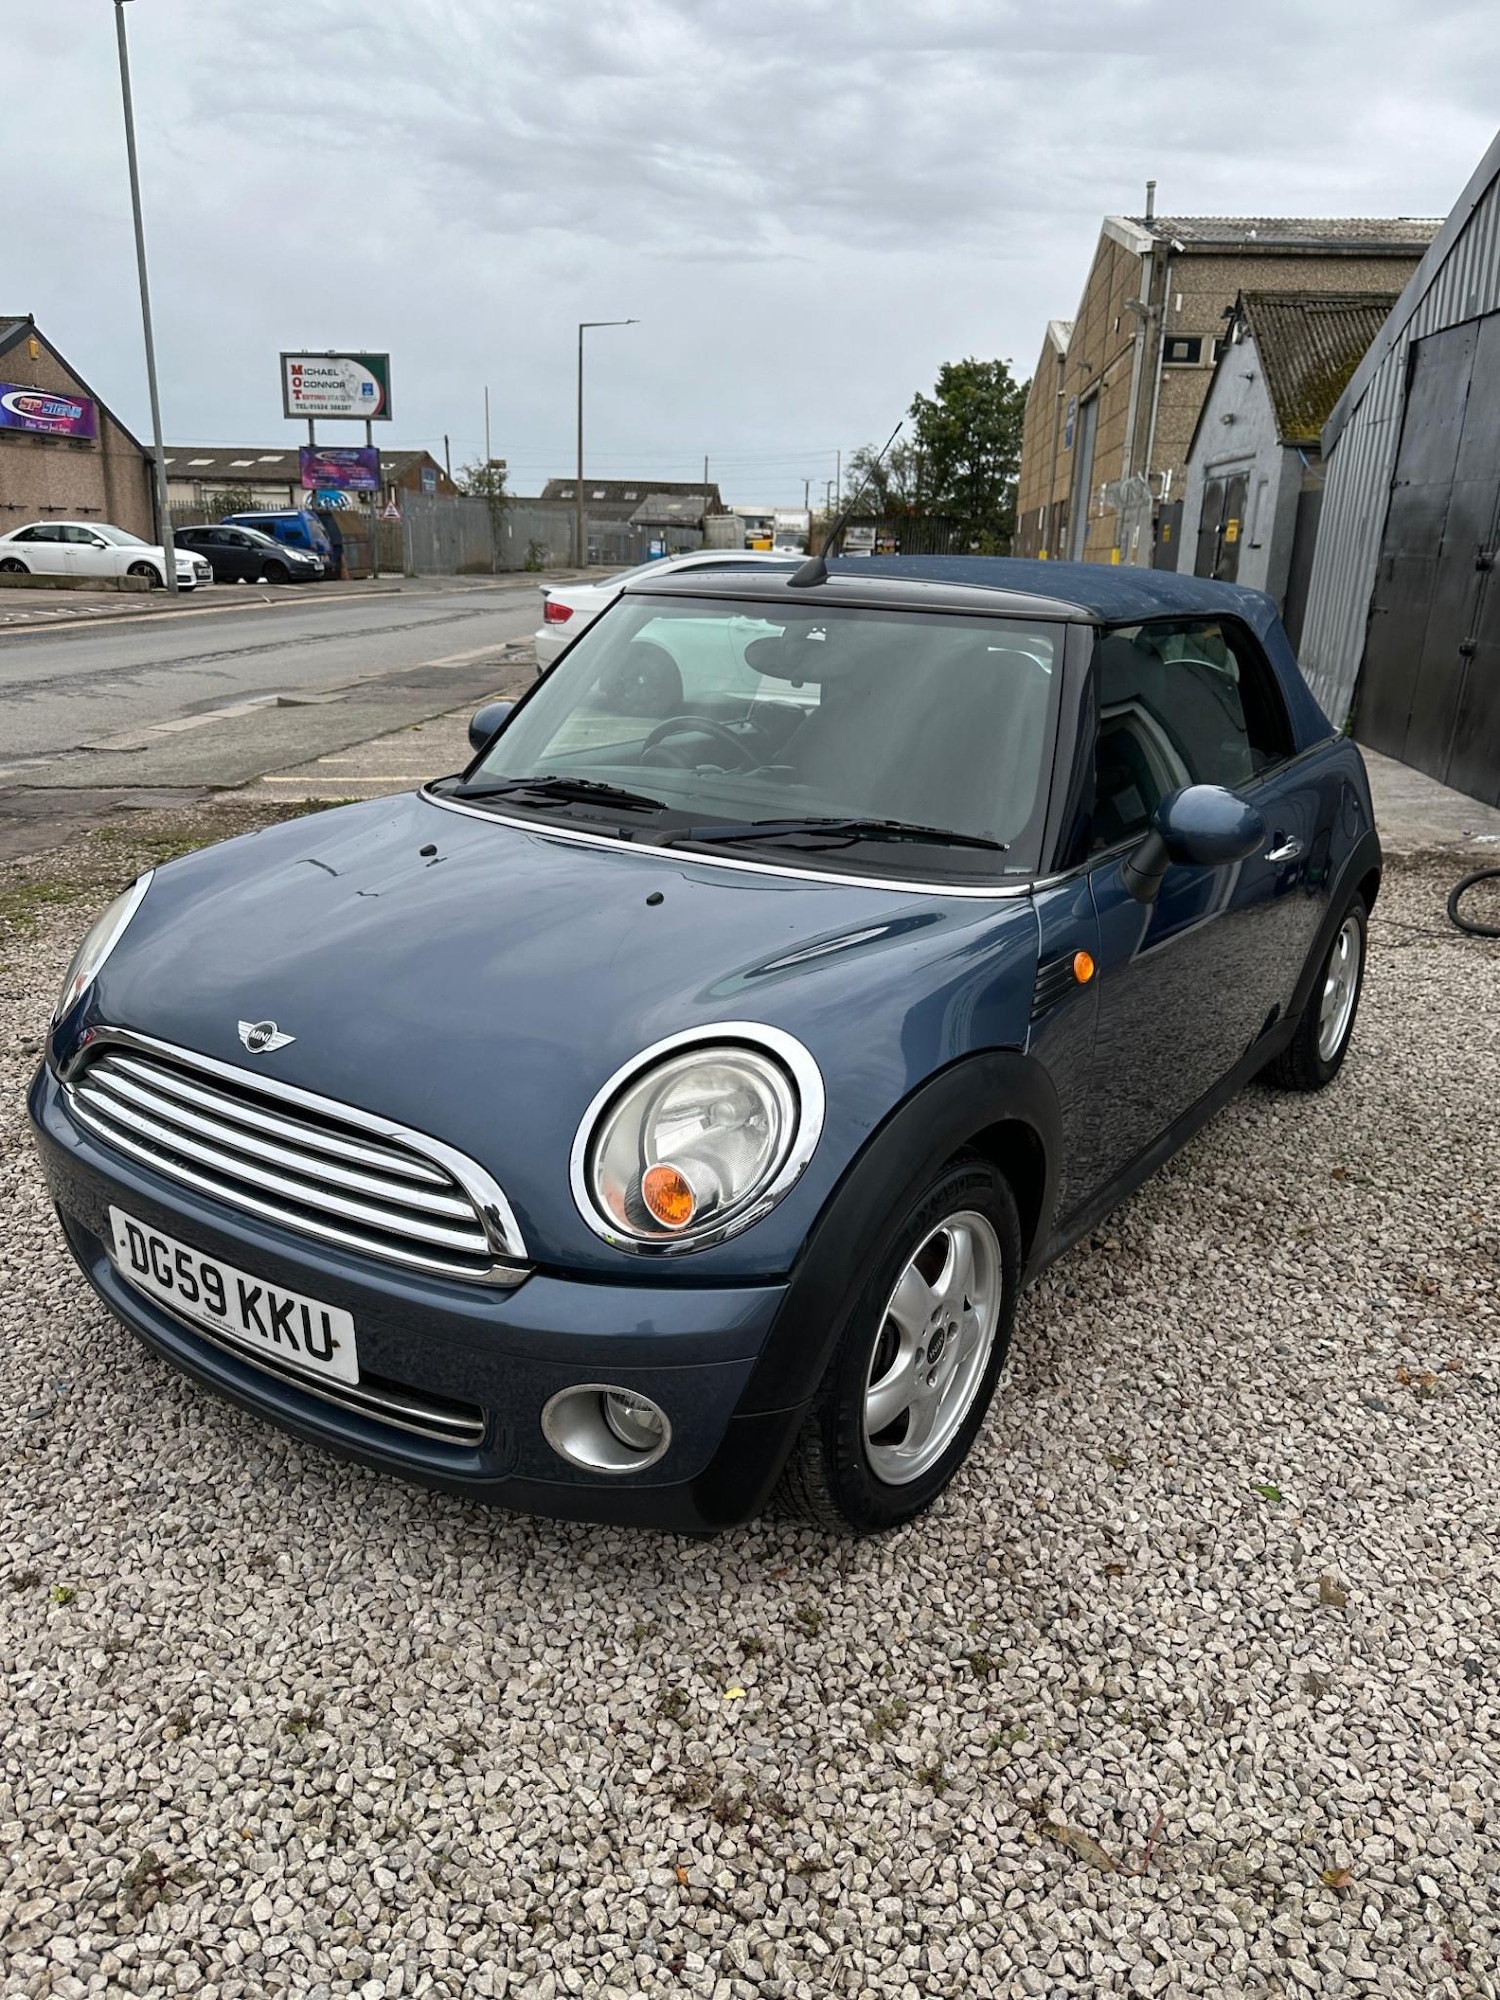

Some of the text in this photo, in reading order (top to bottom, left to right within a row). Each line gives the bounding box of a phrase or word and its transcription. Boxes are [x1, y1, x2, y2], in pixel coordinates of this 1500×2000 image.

[291, 365, 339, 376] MICHAEL
[42, 401, 83, 419] SIGNS
[249, 1029, 271, 1042] MINI
[125, 1219, 334, 1362] DG59 KKU
